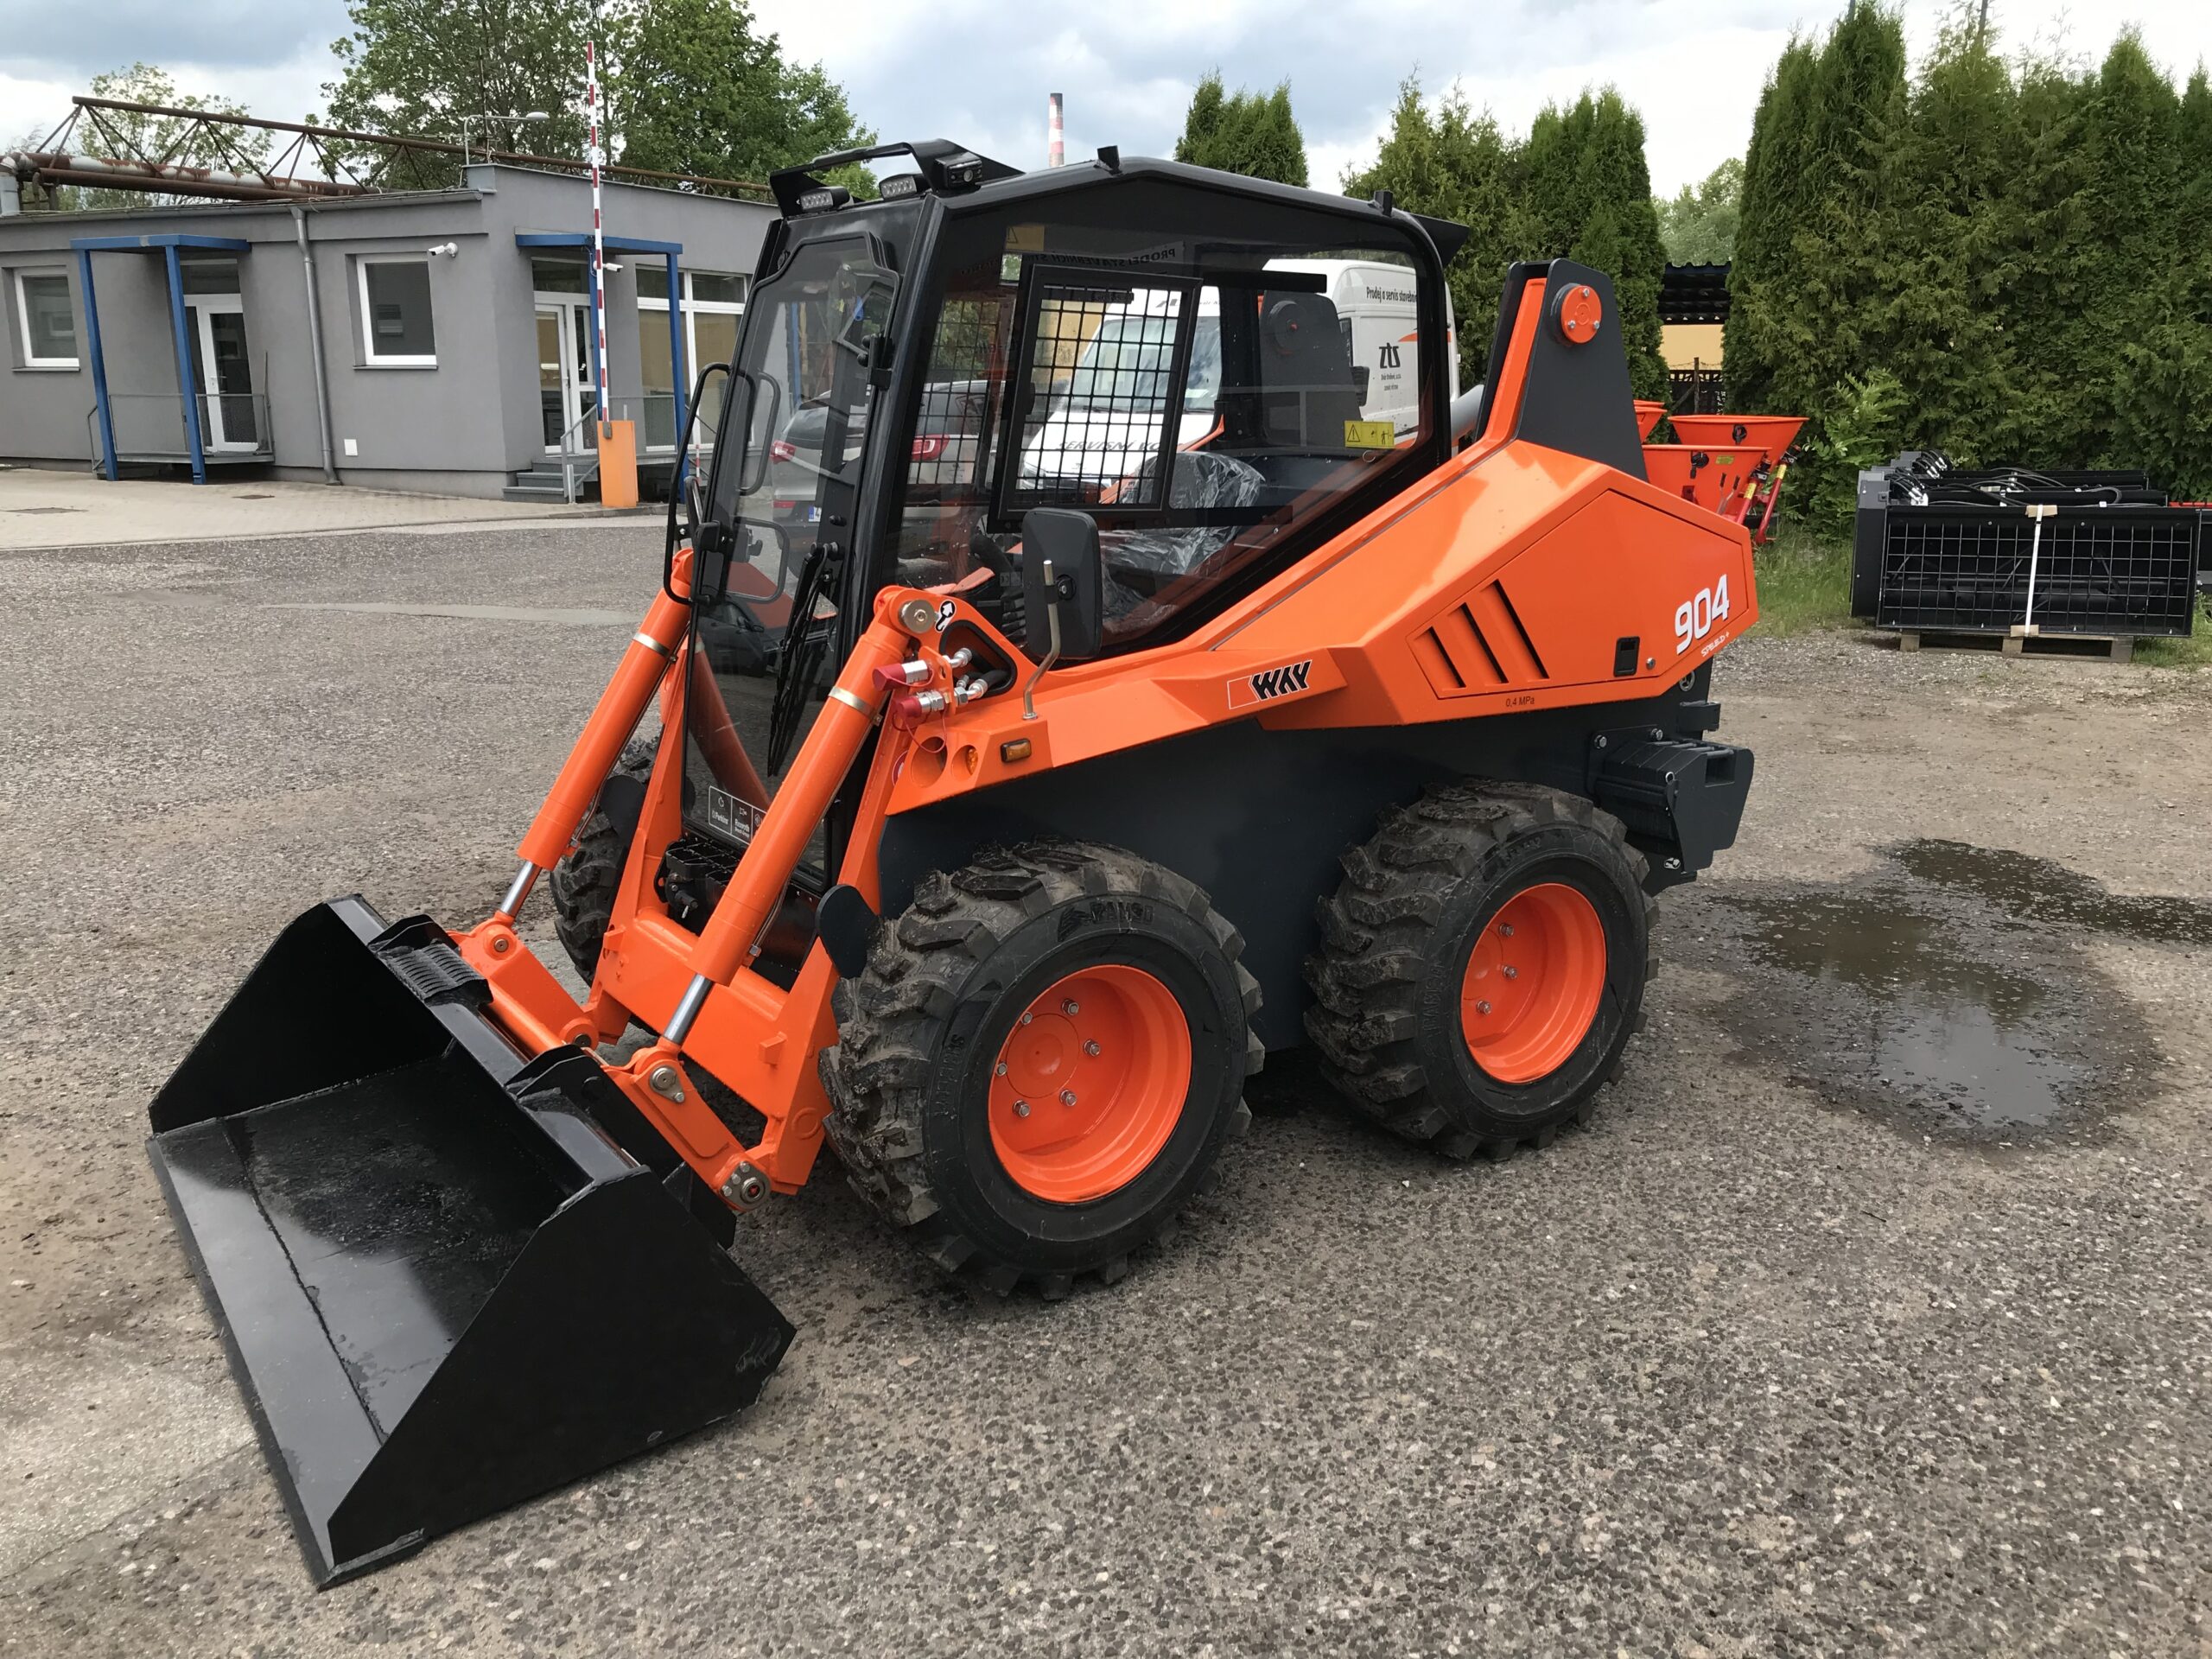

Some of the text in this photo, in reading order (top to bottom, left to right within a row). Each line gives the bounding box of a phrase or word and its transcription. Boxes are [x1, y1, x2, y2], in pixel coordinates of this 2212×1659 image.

[1675, 573, 1730, 656] 904
[1250, 659, 1313, 701] WAY
[1519, 696, 1535, 705] MPa
